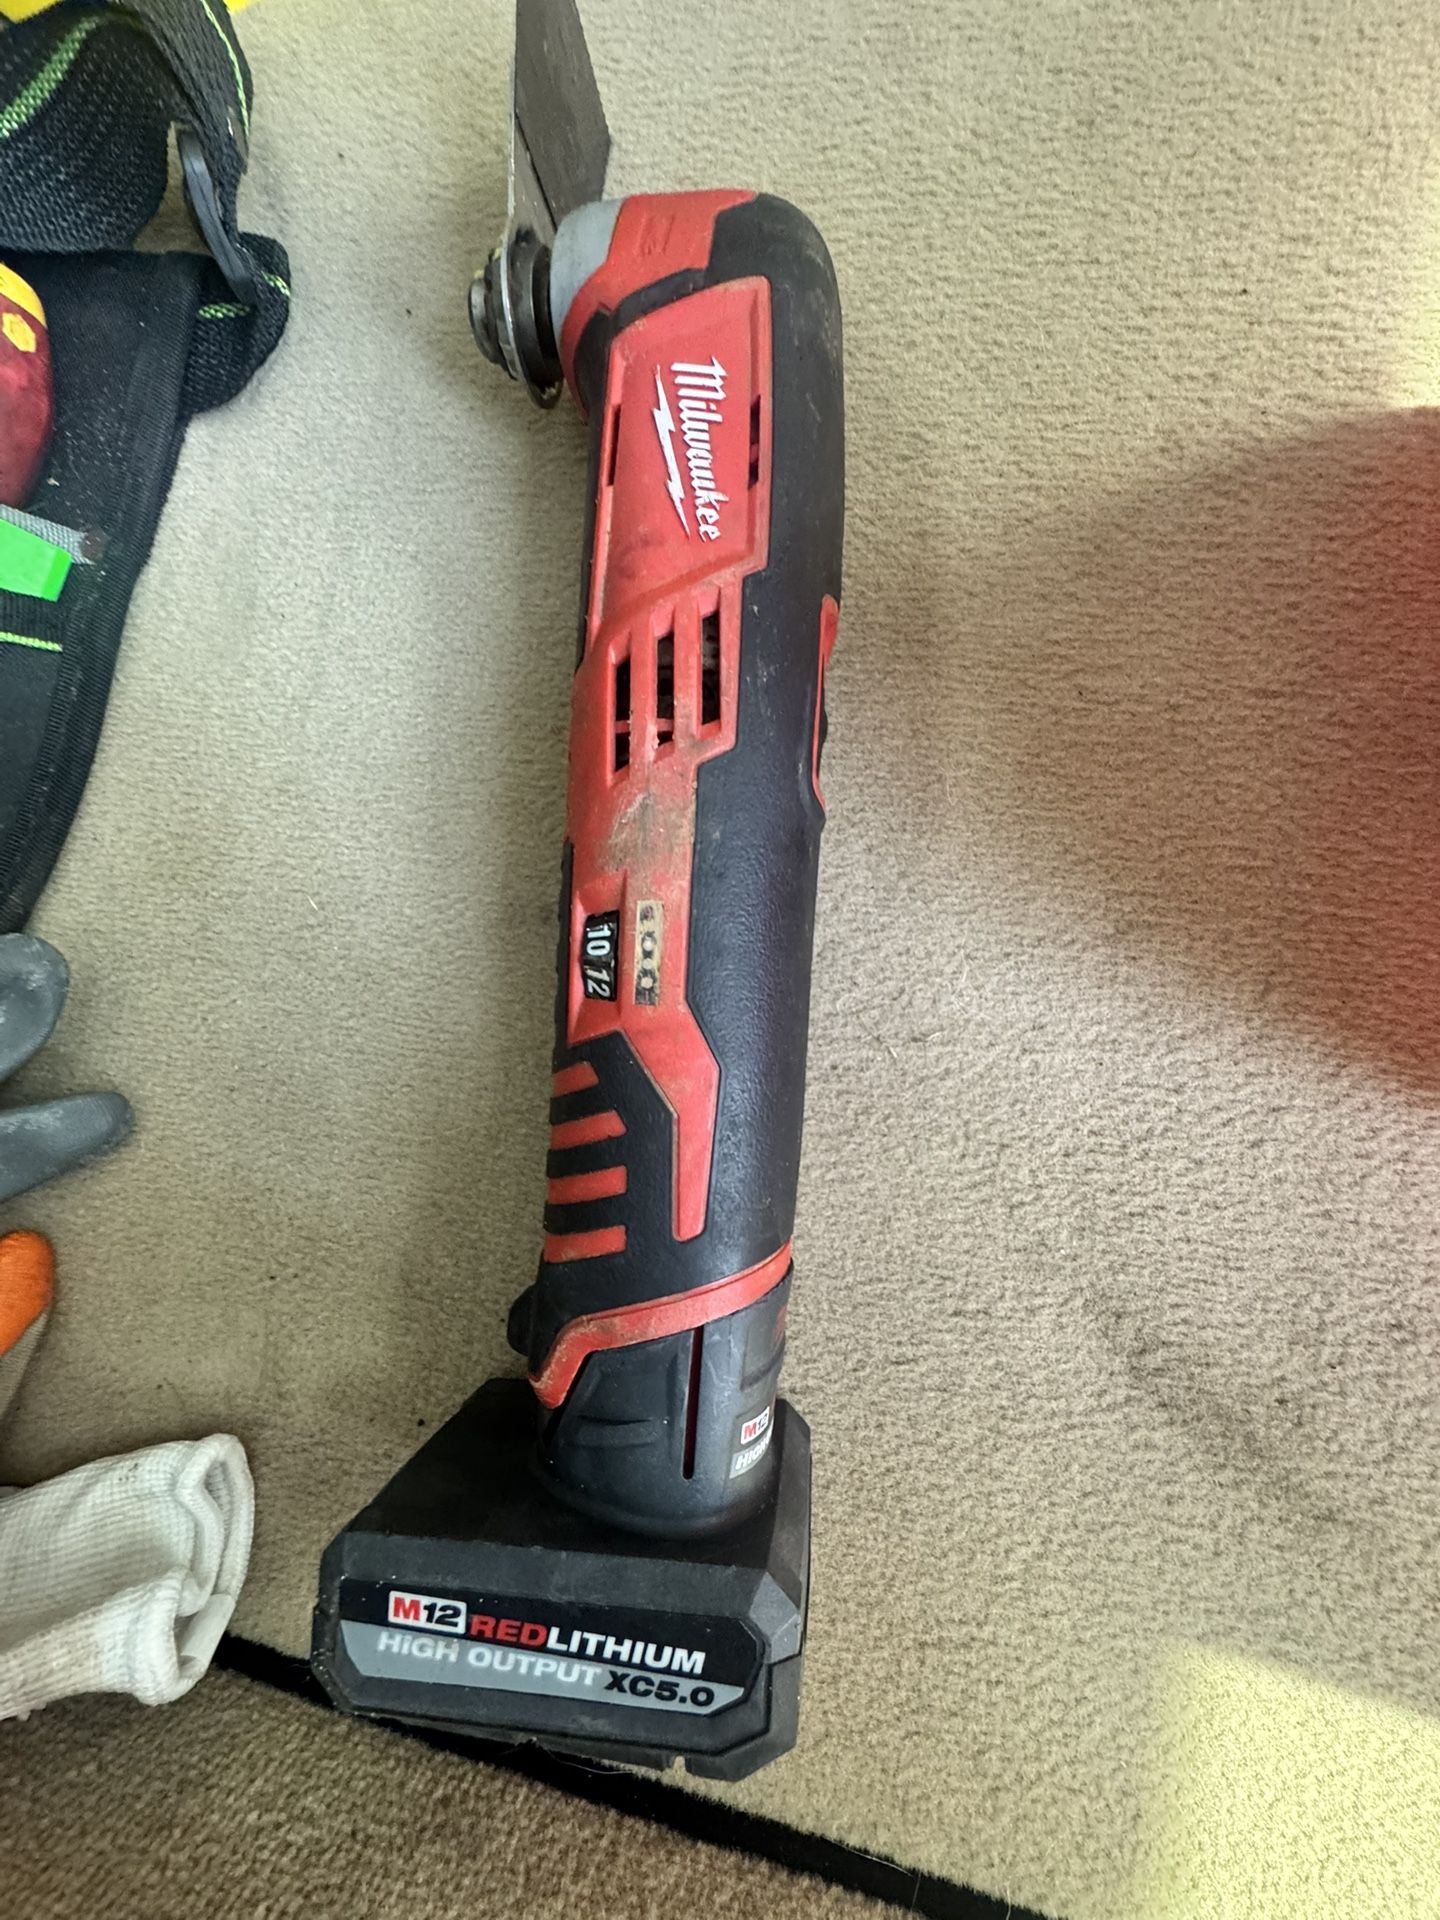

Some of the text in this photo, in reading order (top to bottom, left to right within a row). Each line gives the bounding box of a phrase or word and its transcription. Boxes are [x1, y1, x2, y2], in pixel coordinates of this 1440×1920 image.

[670, 356, 729, 543] Milwaukee
[392, 1595, 463, 1628] M12
[376, 1630, 715, 1708] HIGH OUTPUT XC5.0
